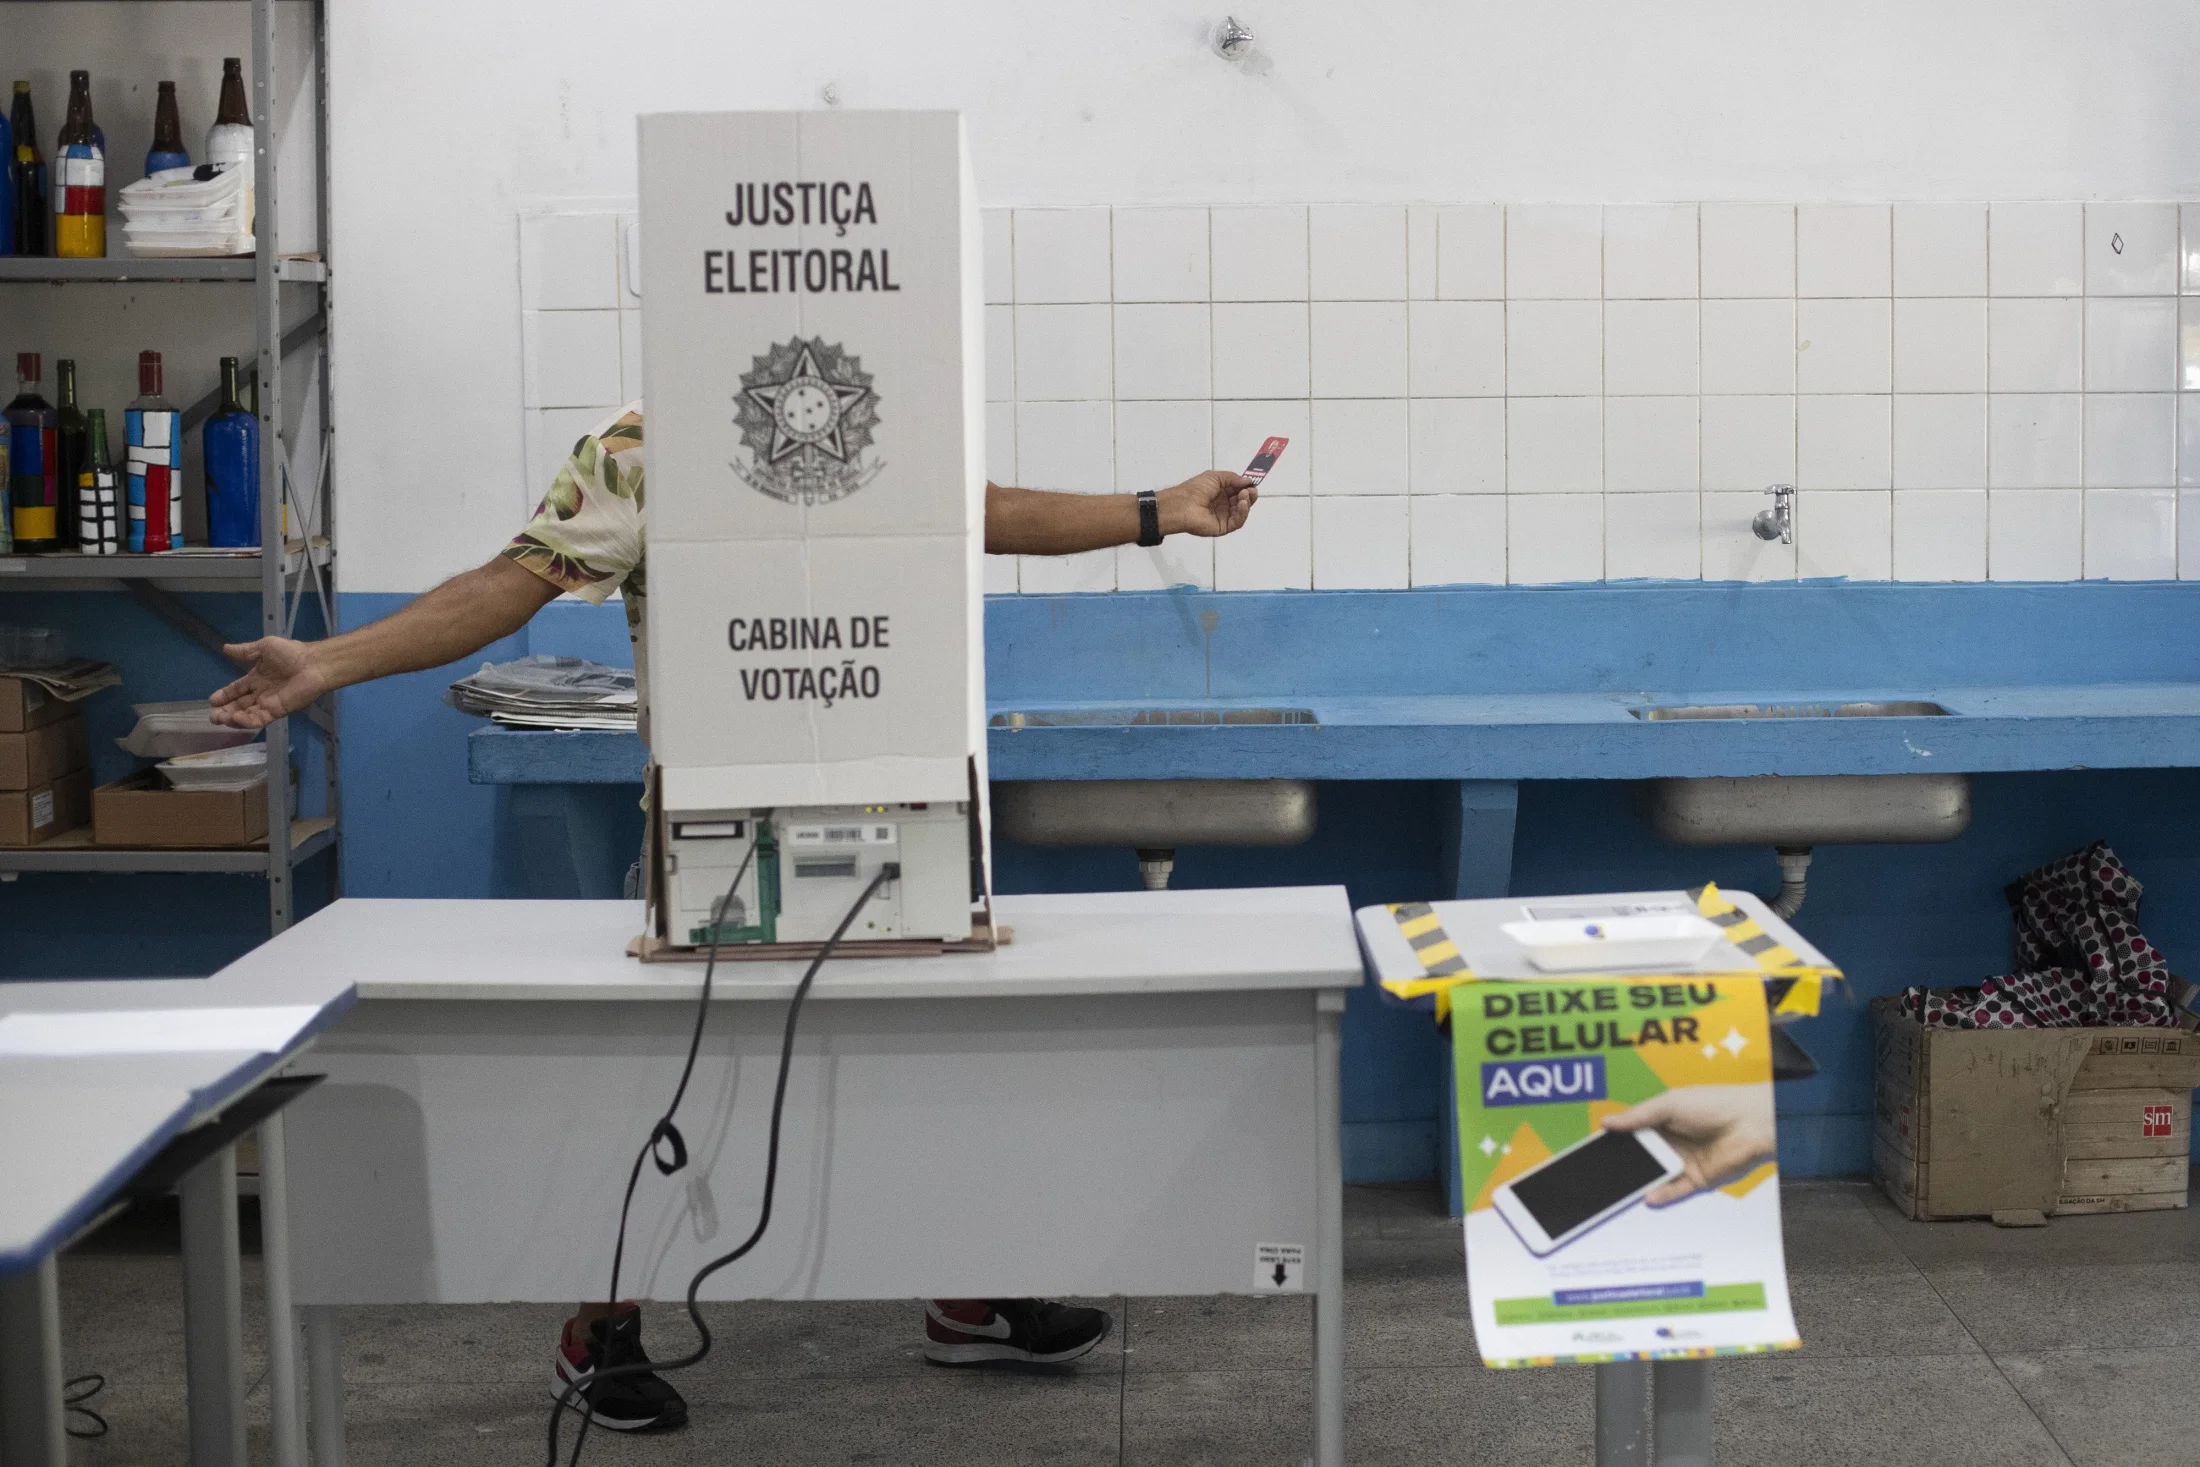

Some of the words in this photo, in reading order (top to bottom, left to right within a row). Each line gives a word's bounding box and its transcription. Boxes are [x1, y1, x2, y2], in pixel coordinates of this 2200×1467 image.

[725, 181, 877, 237] JUSTIÇA
[704, 248, 901, 294] ELEITORAL
[728, 617, 842, 651] CABINA
[850, 615, 889, 648] DE
[739, 659, 880, 708] VOTAÇÃO
[1482, 986, 1619, 1019] DEIXE
[1628, 983, 1717, 1009] SEU
[1484, 1016, 1699, 1056] CELULAR
[1486, 1062, 1594, 1099] AQUI
